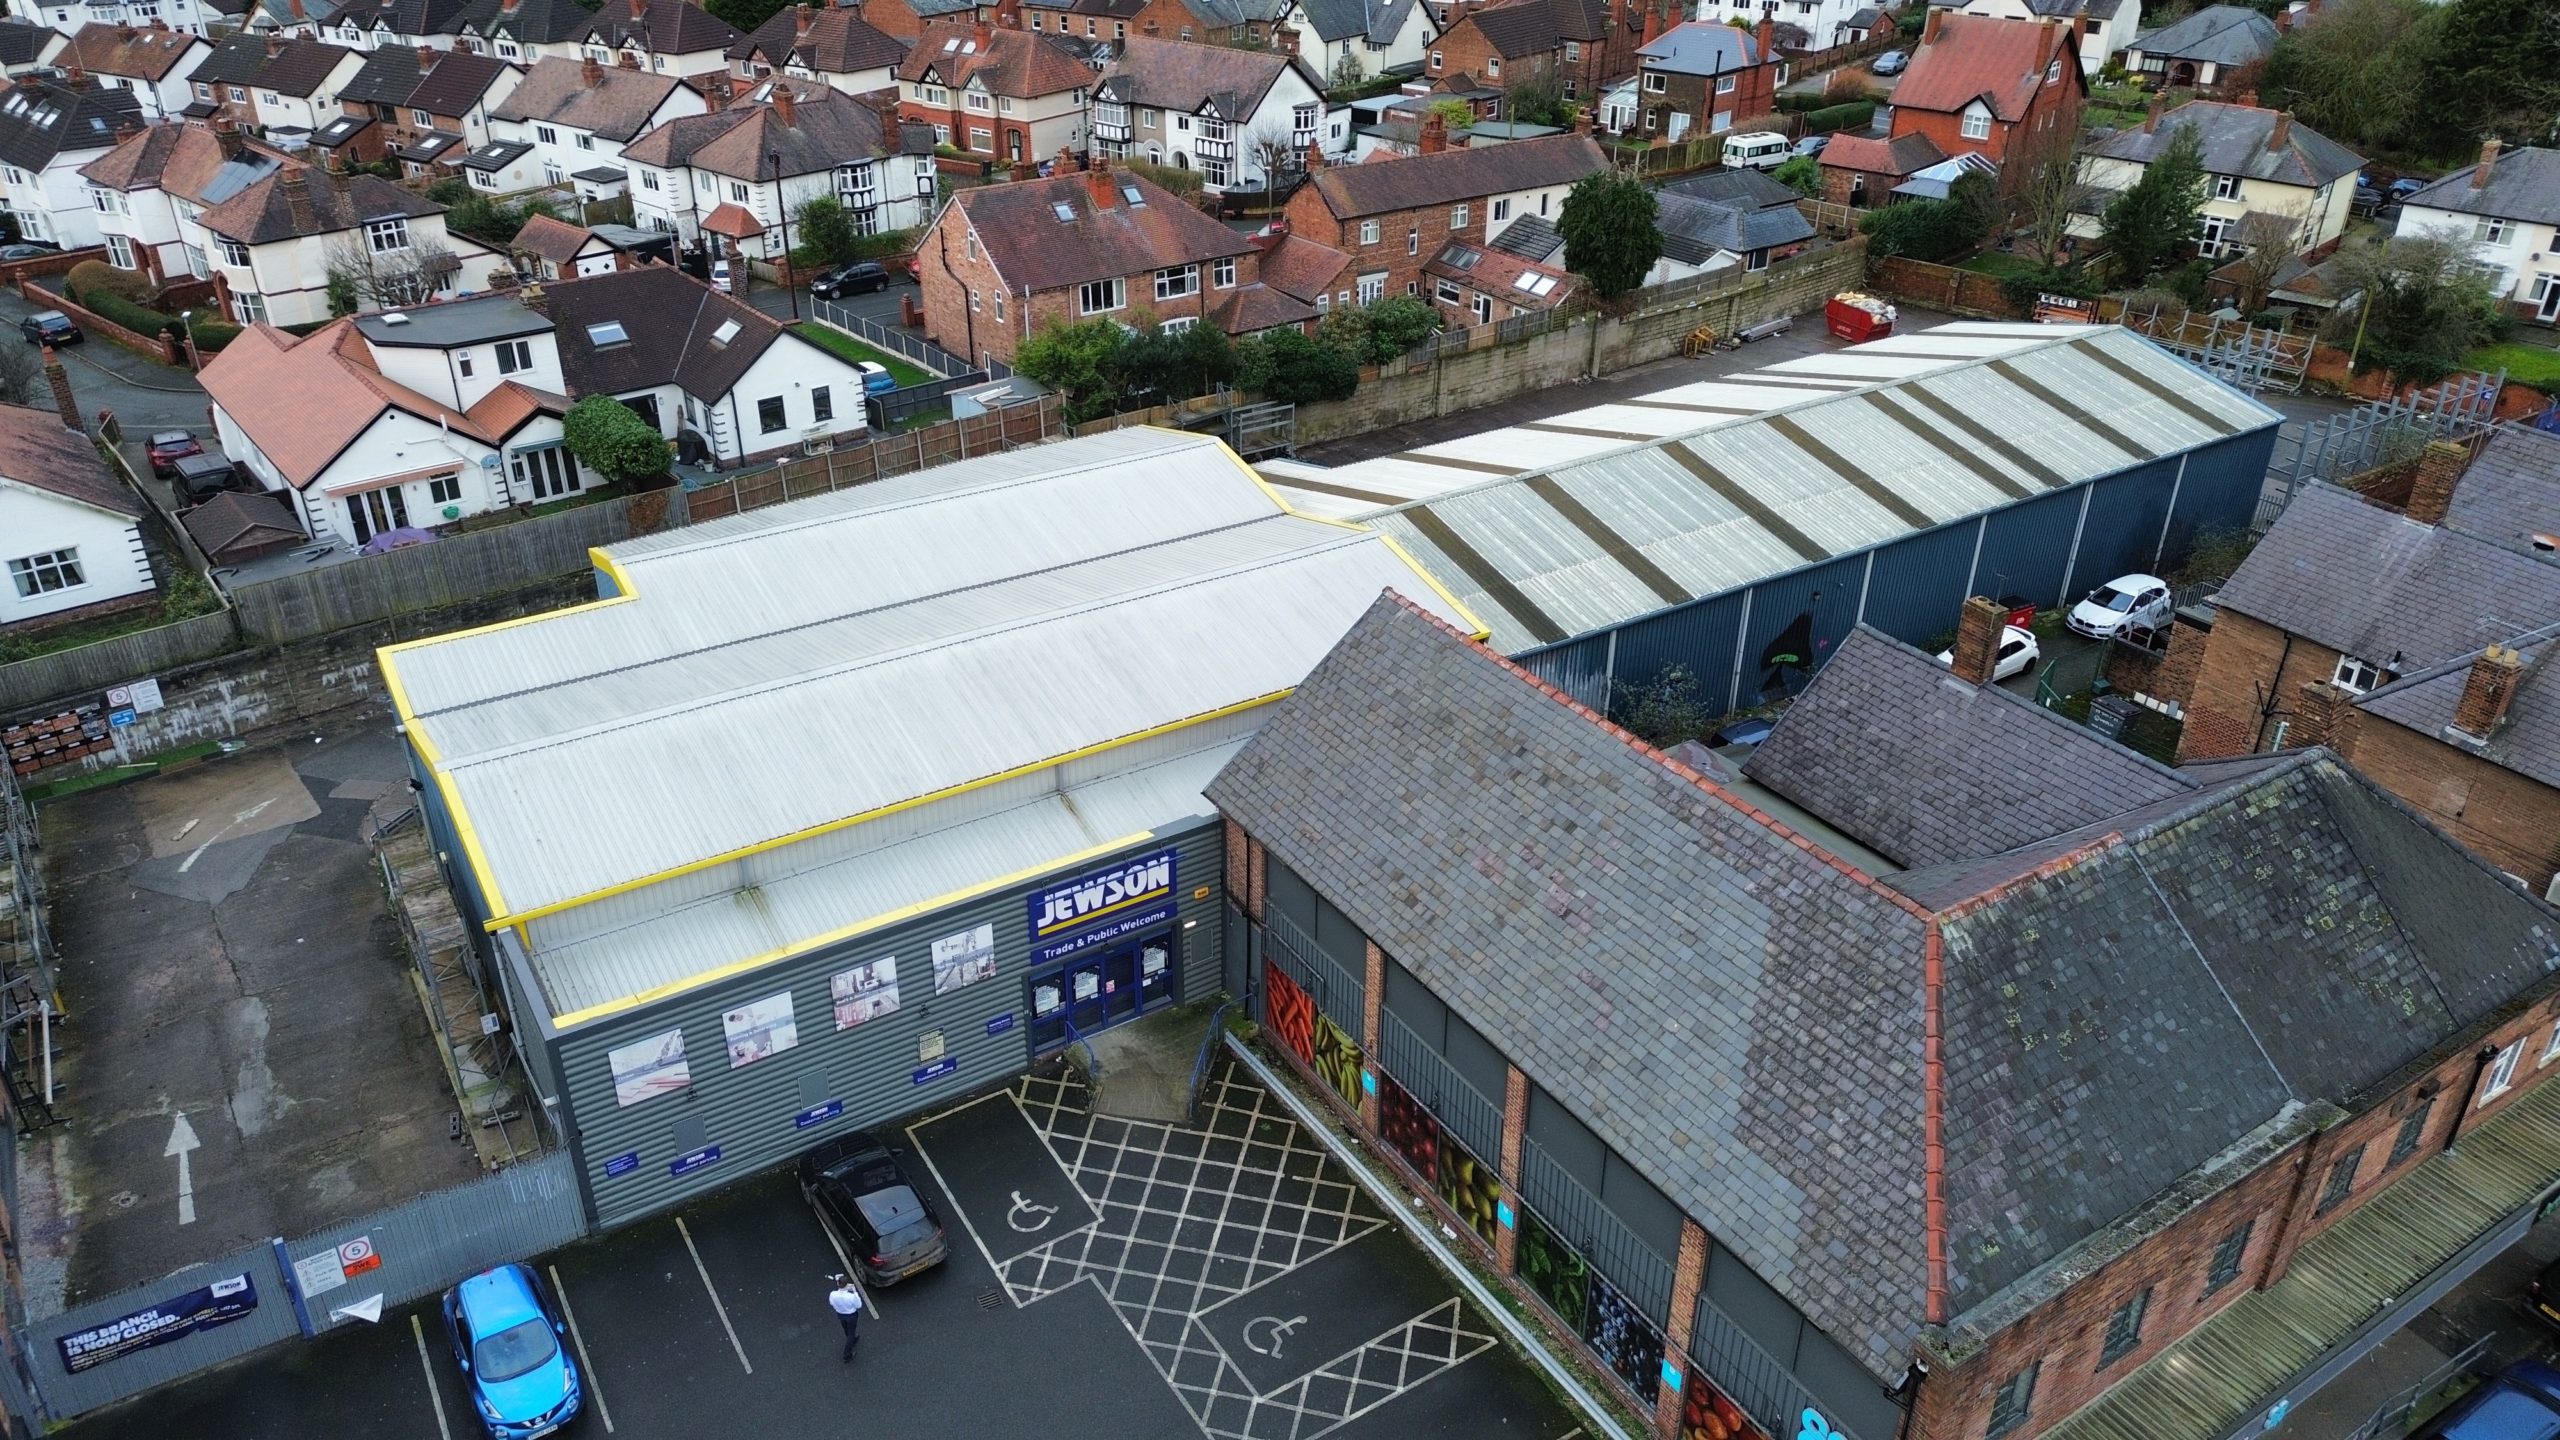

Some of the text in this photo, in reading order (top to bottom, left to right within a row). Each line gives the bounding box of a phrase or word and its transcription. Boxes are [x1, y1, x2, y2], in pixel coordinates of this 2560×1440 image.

[1037, 855, 1170, 929] JEWSON
[1043, 910, 1166, 959] Trade & Public Welcome
[351, 1245, 361, 1256] 5
[216, 1280, 242, 1292] JEWSON
[63, 1330, 98, 1348] THIS
[99, 1310, 159, 1338] BRANCH
[67, 1345, 83, 1357] IS
[83, 1332, 122, 1352] NOW
[122, 1313, 181, 1339] CLOSED.
